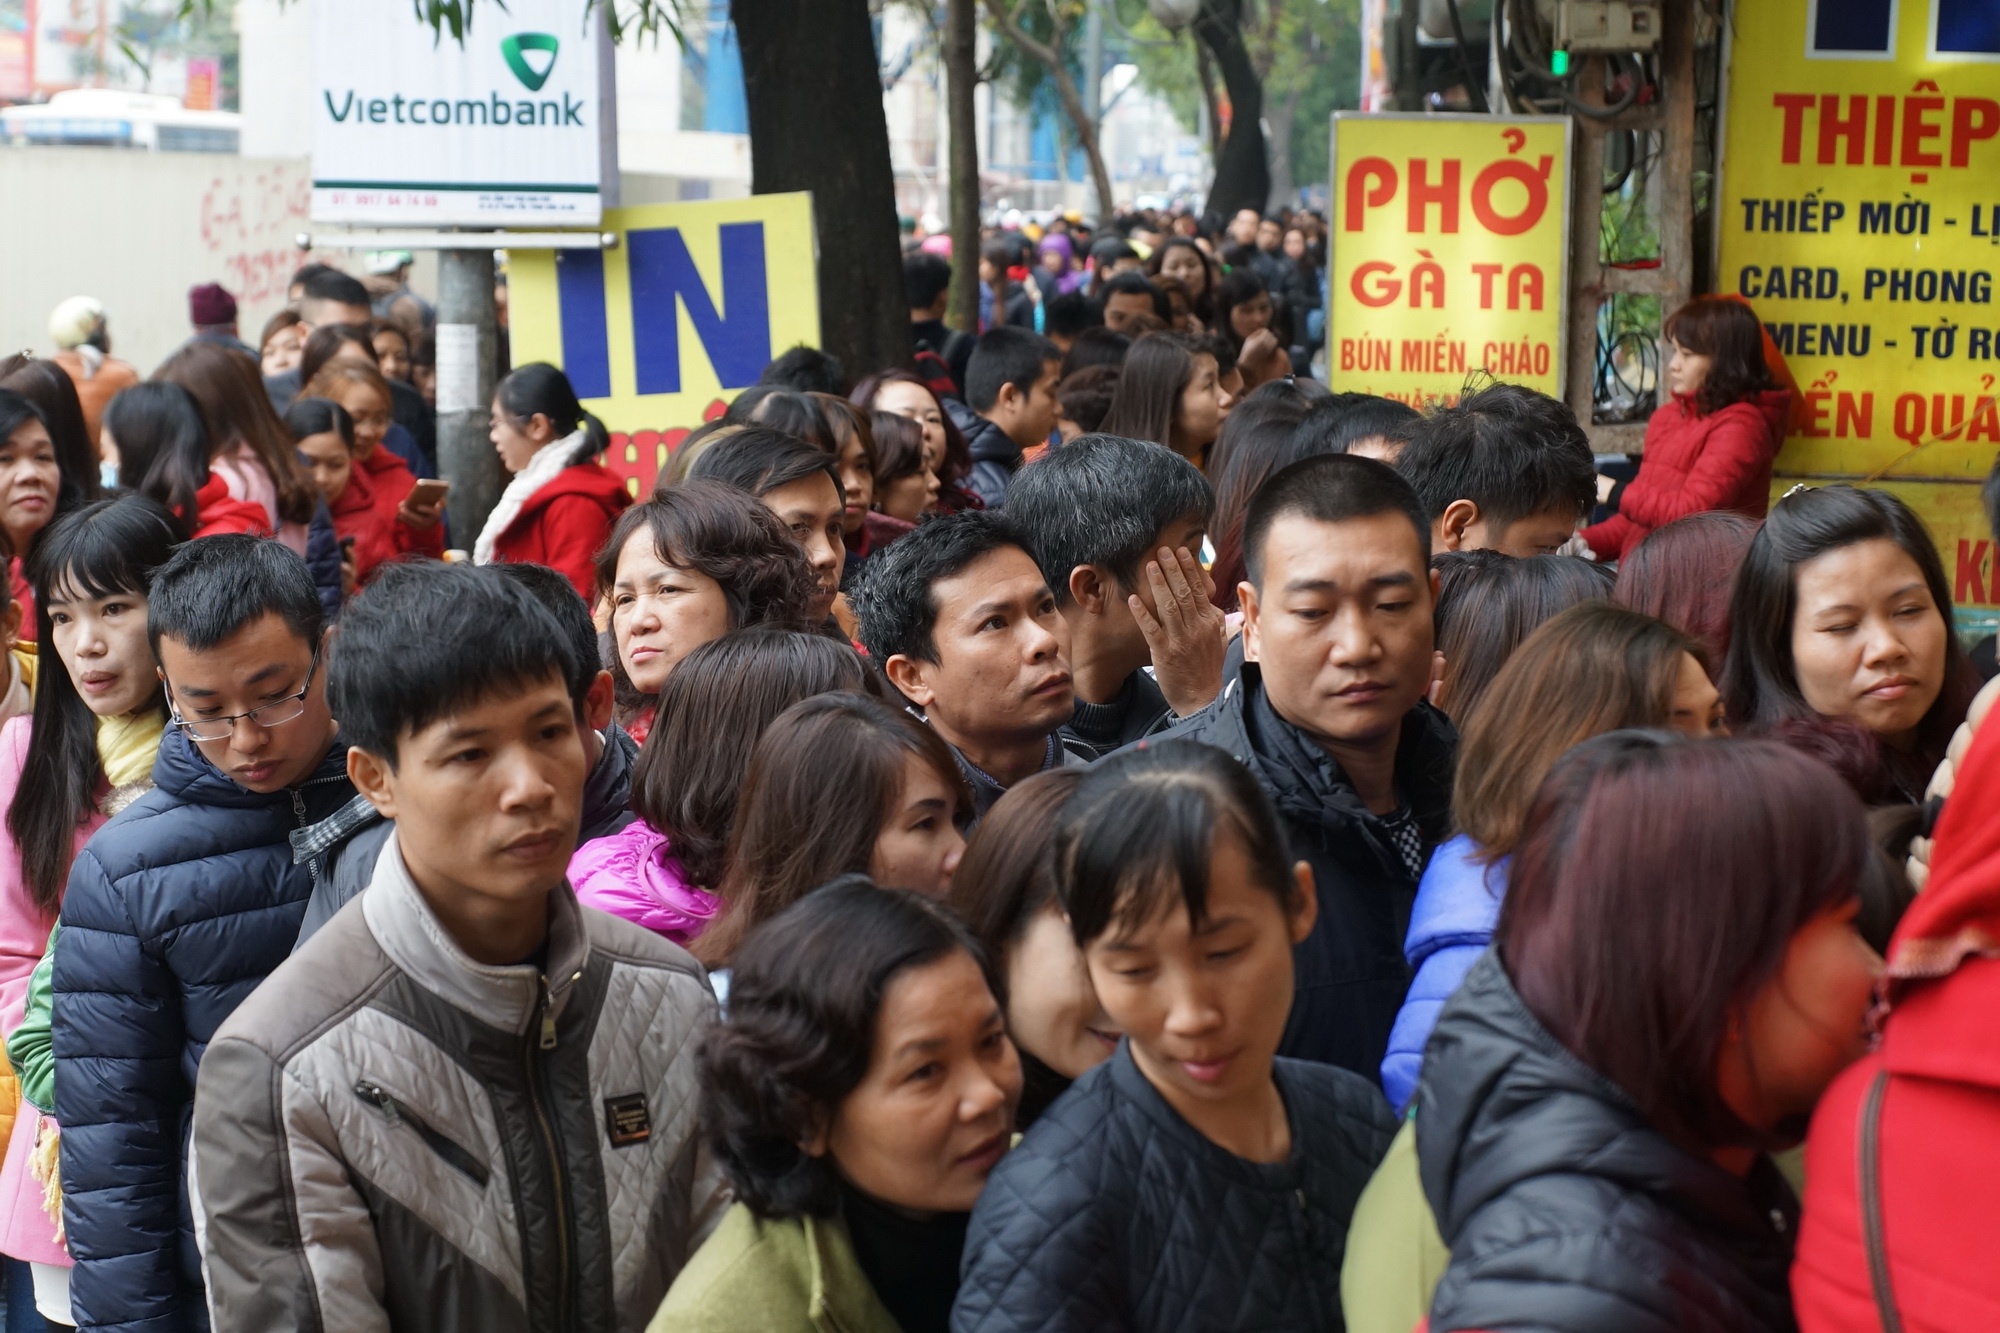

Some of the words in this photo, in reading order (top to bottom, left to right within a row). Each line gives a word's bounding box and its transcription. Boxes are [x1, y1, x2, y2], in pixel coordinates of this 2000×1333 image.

[324, 89, 584, 127] Vietcombank
[1773, 79, 2000, 184] THIỆP
[1344, 127, 1554, 236] PHỞ
[1741, 187, 1846, 234] THIẾP
[1858, 193, 1931, 236] MỜI
[1350, 248, 1445, 309] GÀ
[1471, 263, 1544, 311] TA
[1739, 264, 1849, 306] CARD,
[1863, 266, 1993, 304] PHONG
[555, 220, 772, 400] IN
[1340, 331, 1392, 372] BÚN
[1482, 335, 1551, 377] CHÁO
[1763, 321, 1872, 357] MENU
[1911, 317, 1959, 359] TỜ
